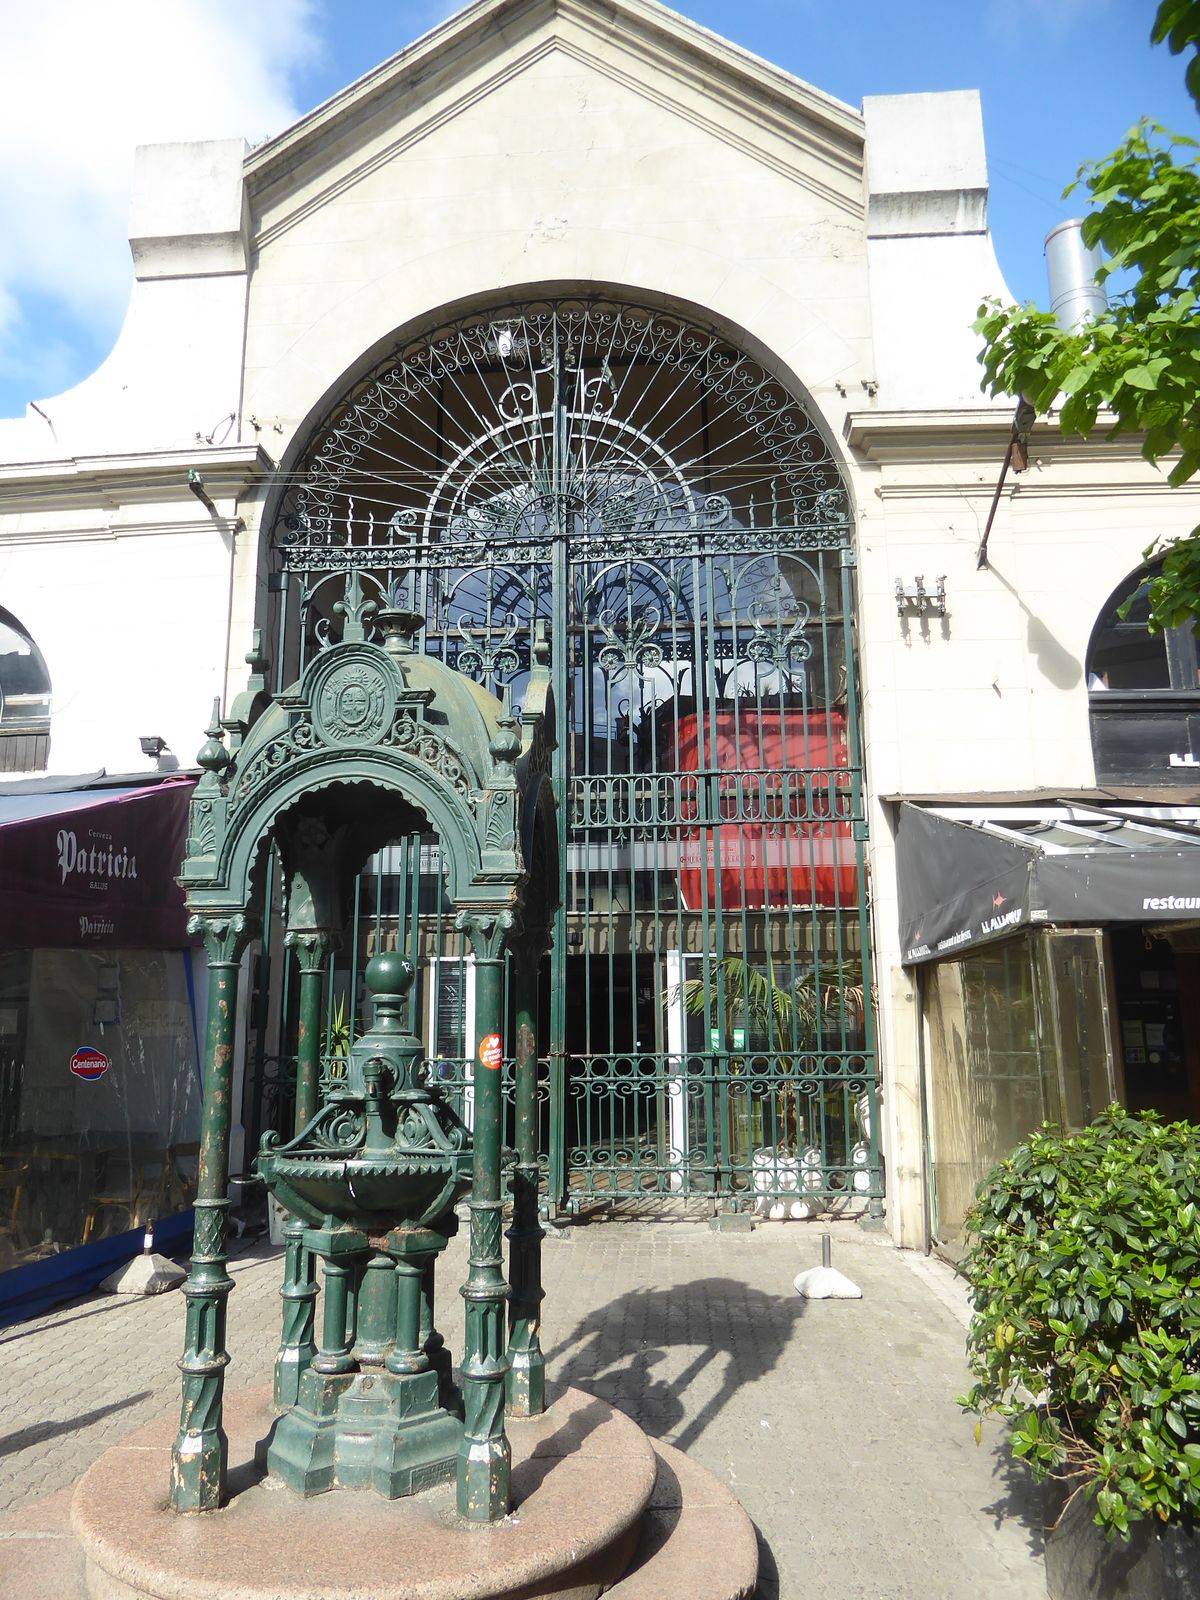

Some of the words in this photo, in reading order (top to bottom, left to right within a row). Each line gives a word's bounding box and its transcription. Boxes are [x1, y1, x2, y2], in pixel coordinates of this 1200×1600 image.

[88, 829, 112, 840] Cerveza
[56, 829, 138, 886] Patricia
[79, 915, 115, 939] Patricia
[72, 1059, 106, 1069] Centenario
